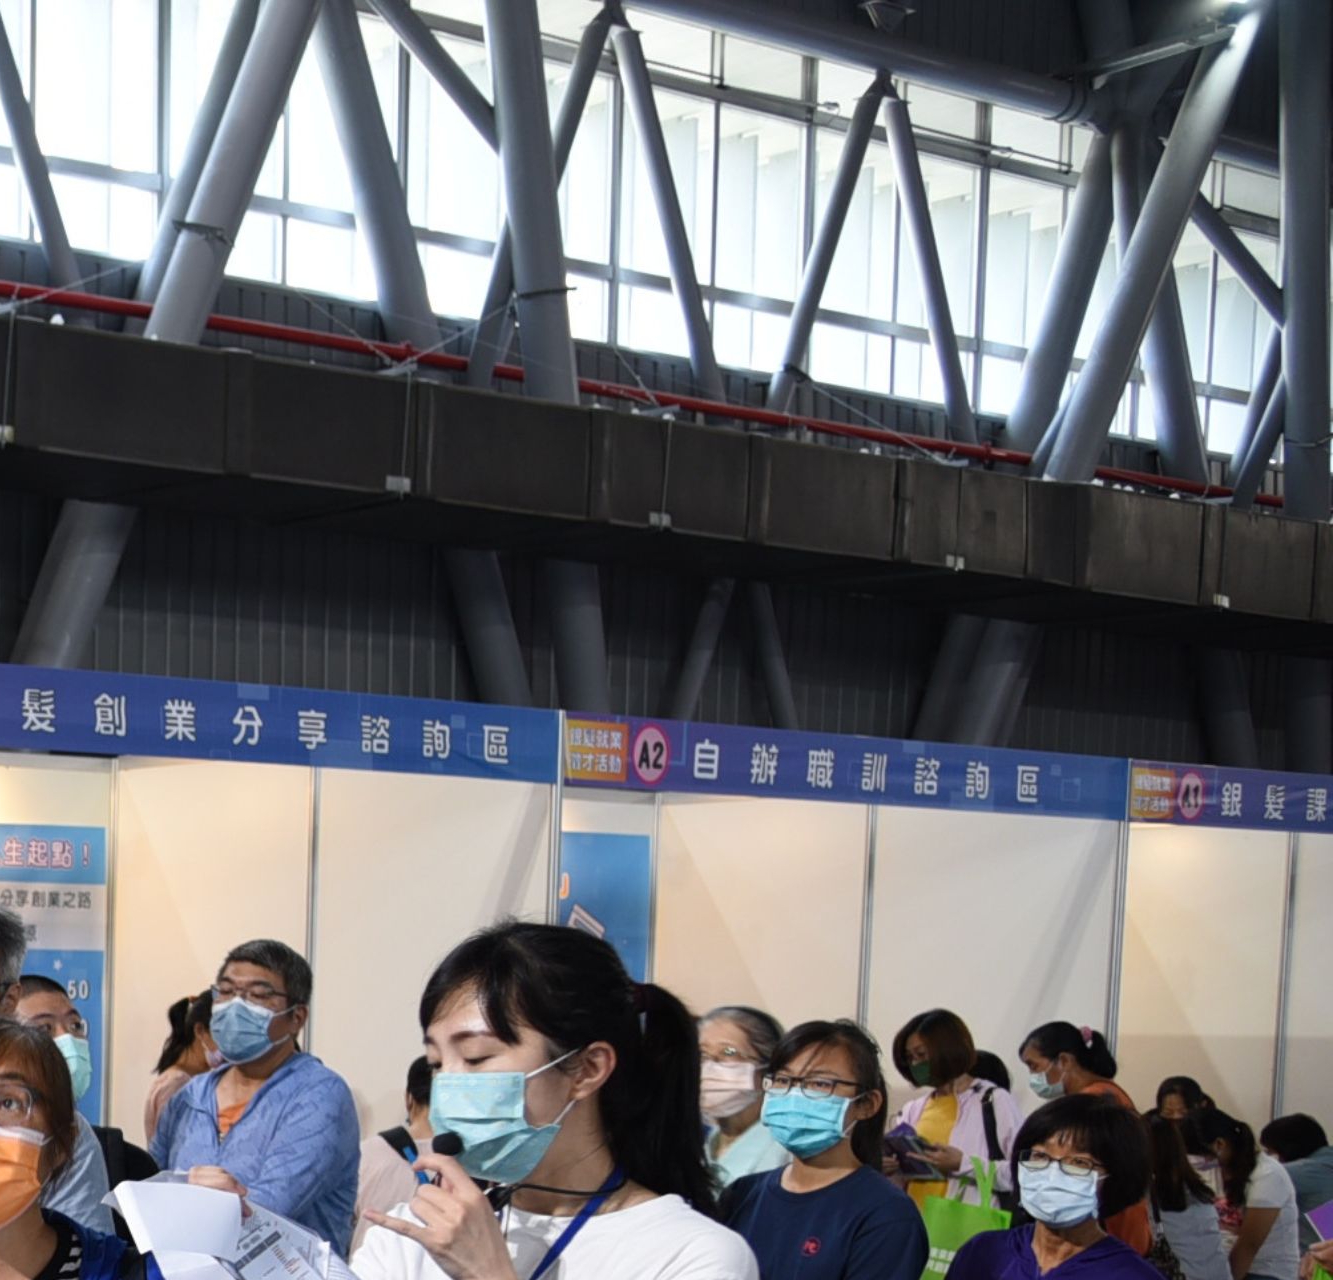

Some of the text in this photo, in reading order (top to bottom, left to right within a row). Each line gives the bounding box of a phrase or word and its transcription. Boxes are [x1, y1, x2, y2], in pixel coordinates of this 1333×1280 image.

[638, 740, 664, 769] A2
[694, 738, 1039, 803] 自辦職訓諮詢區
